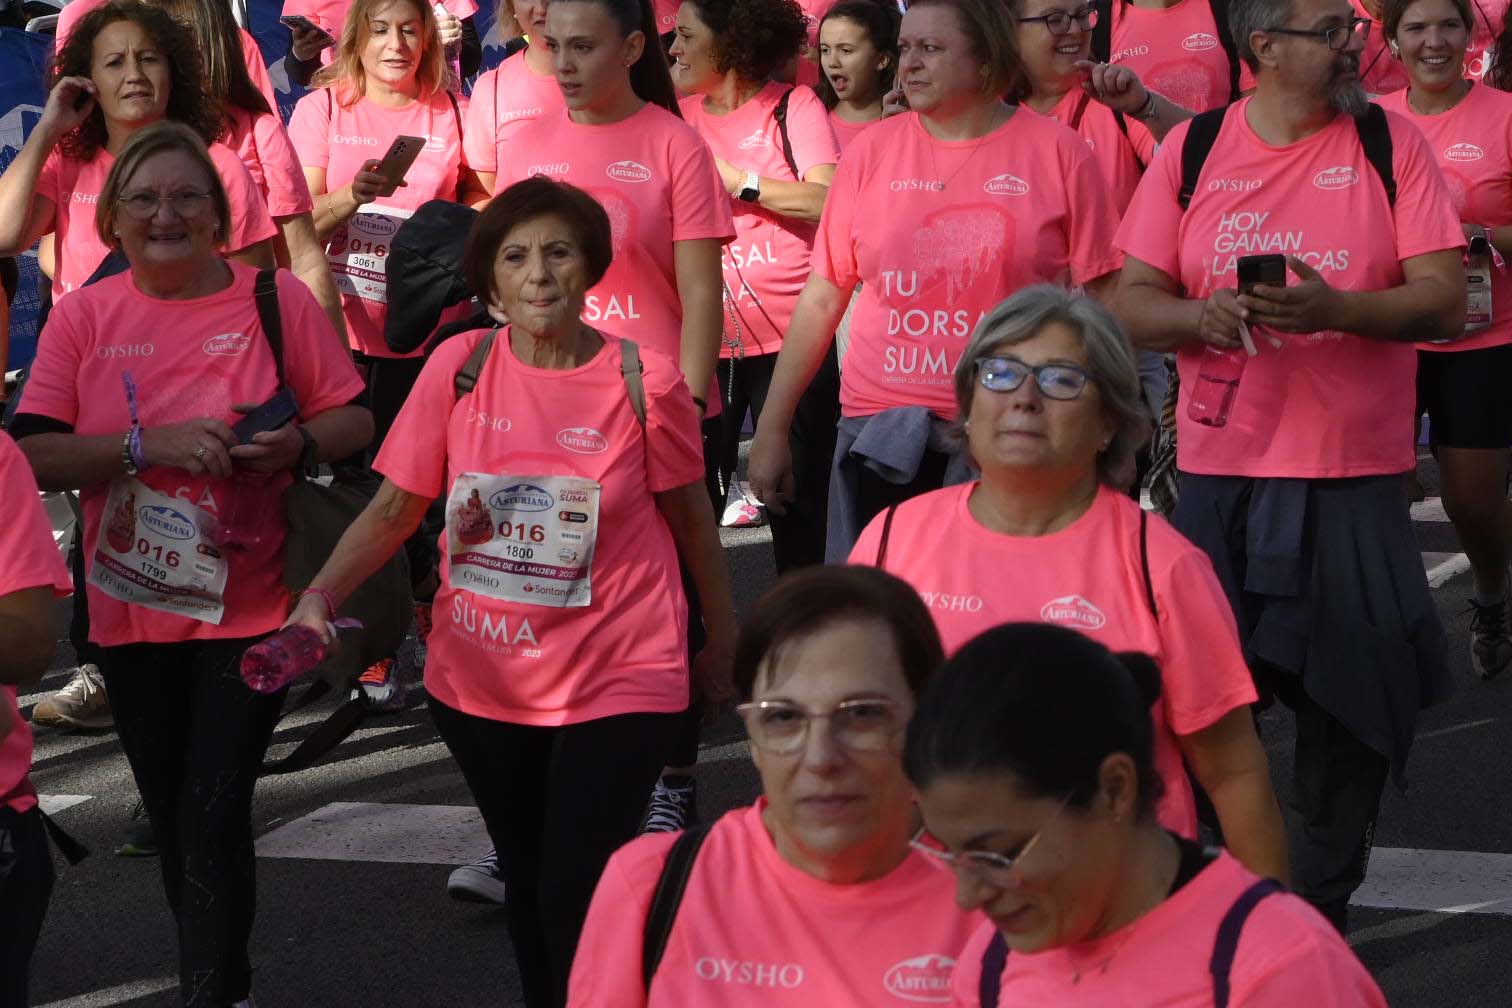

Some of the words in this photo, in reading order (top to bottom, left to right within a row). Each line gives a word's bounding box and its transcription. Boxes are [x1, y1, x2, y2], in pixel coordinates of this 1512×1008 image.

[609, 167, 648, 179] ASTURIANA
[1208, 178, 1263, 193] OYSHO
[1217, 210, 1270, 233] HOY
[350, 238, 387, 258] 016
[1214, 230, 1304, 254] GANAN
[353, 256, 376, 269] 3061
[1211, 254, 1239, 276] LA
[881, 270, 918, 297] TU
[97, 343, 155, 360] OYSHO
[495, 495, 549, 508] ASTURIANA
[558, 494, 588, 504] SUMA
[141, 510, 191, 539] ASTURIANA
[498, 520, 545, 542] 016
[137, 538, 181, 568] 016
[506, 545, 534, 560] 1800
[104, 558, 137, 582] CARRERA
[137, 575, 148, 586] DE
[141, 561, 167, 581] 1799
[466, 554, 501, 570] CARRERA
[502, 561, 513, 572] DE
[514, 563, 526, 573] LA
[527, 565, 556, 577] MUJER
[452, 594, 539, 646] SUMA
[521, 648, 543, 659] 2023
[696, 957, 803, 989] OYSHO
